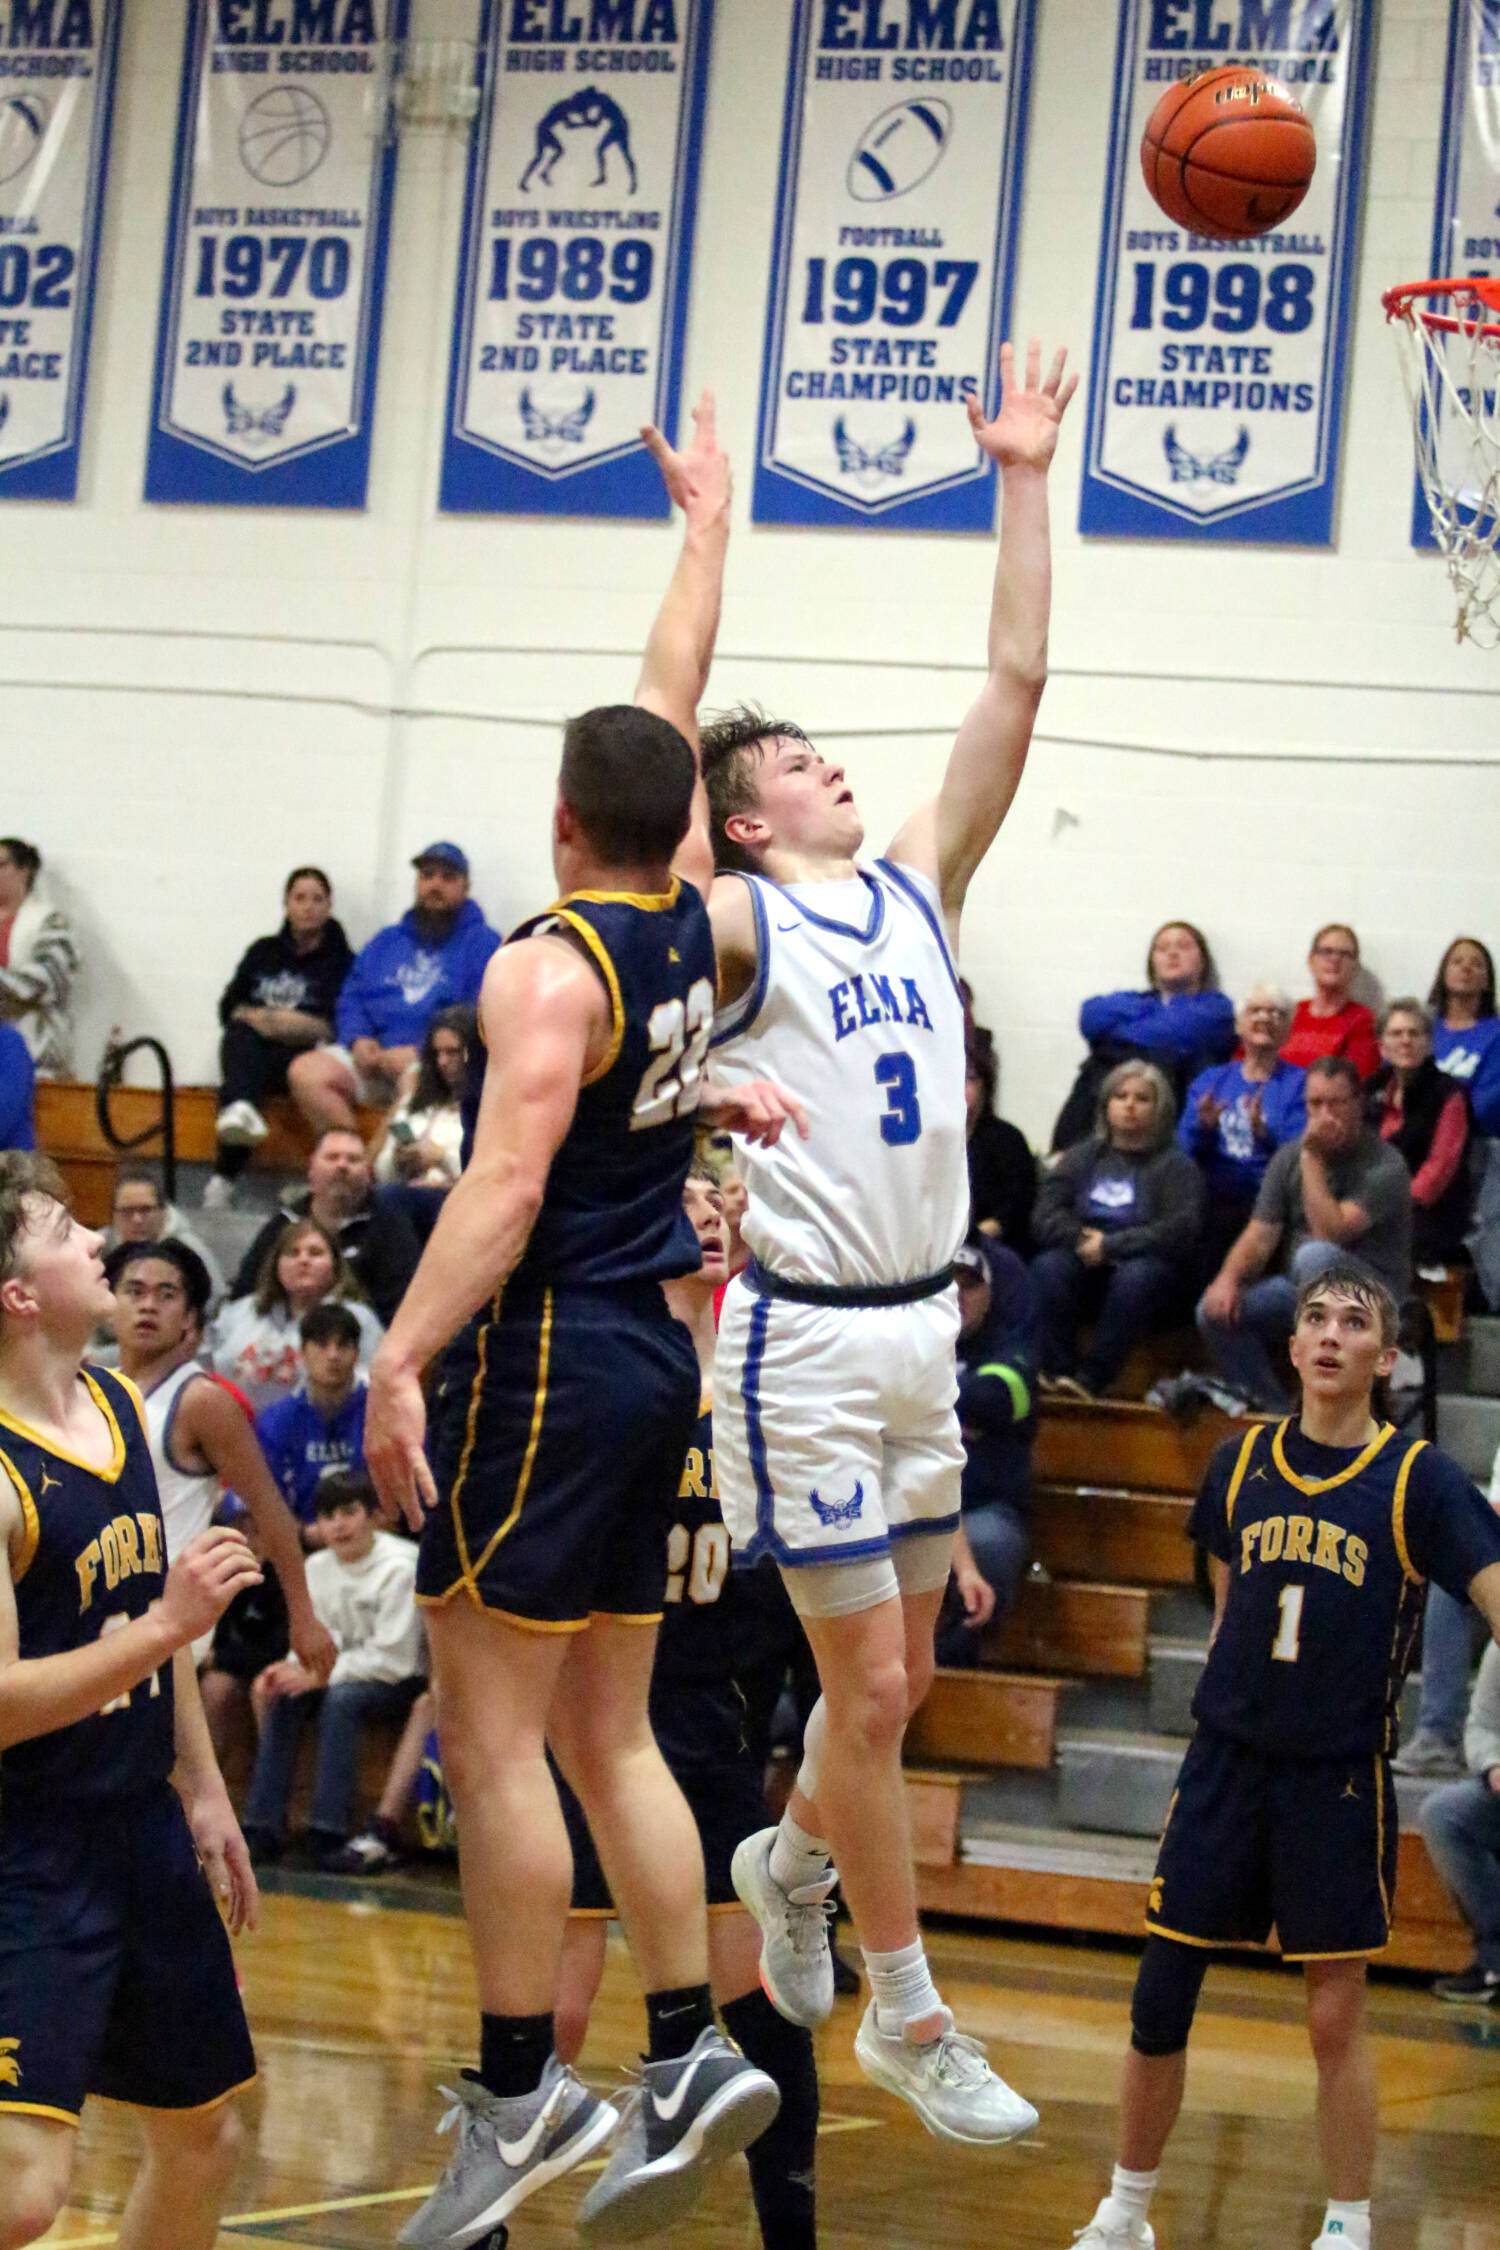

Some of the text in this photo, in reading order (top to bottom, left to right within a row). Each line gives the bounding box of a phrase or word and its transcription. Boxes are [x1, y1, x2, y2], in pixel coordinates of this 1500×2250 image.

[0, 0, 93, 47] MA
[218, 0, 375, 43] ELMA
[508, 0, 678, 42] ELMA
[818, 0, 1003, 50] ELMA
[1147, 0, 1340, 52] ELMA
[278, 52, 375, 73] SCHOOL
[505, 50, 676, 72] HIGH SCHOOL
[815, 56, 1003, 82] HIGH SCHOOL
[244, 208, 362, 228] BASKETBALL
[547, 210, 661, 230] WRESTLING
[839, 227, 944, 248] FOOTBALL
[1126, 231, 1180, 251] BOYS
[195, 235, 350, 300] 1970
[488, 236, 655, 304] 1989
[801, 256, 980, 328] 1997
[1130, 261, 1316, 334] 1998
[220, 309, 316, 337] STATE
[516, 313, 615, 341] STATE
[184, 339, 347, 369] 2ND PLACE
[478, 344, 648, 374] 2ND PLACE
[829, 337, 939, 368] STATE
[1160, 344, 1273, 375] STATE
[785, 371, 979, 404] CHAMPIONS
[1114, 377, 1315, 413] CHAMPIONS
[828, 973, 935, 1043] ELMA
[873, 1051, 922, 1147] 3
[75, 1512, 163, 1617] FORK
[1240, 1515, 1369, 1588] FORKS
[1271, 1583, 1306, 1662] 1
